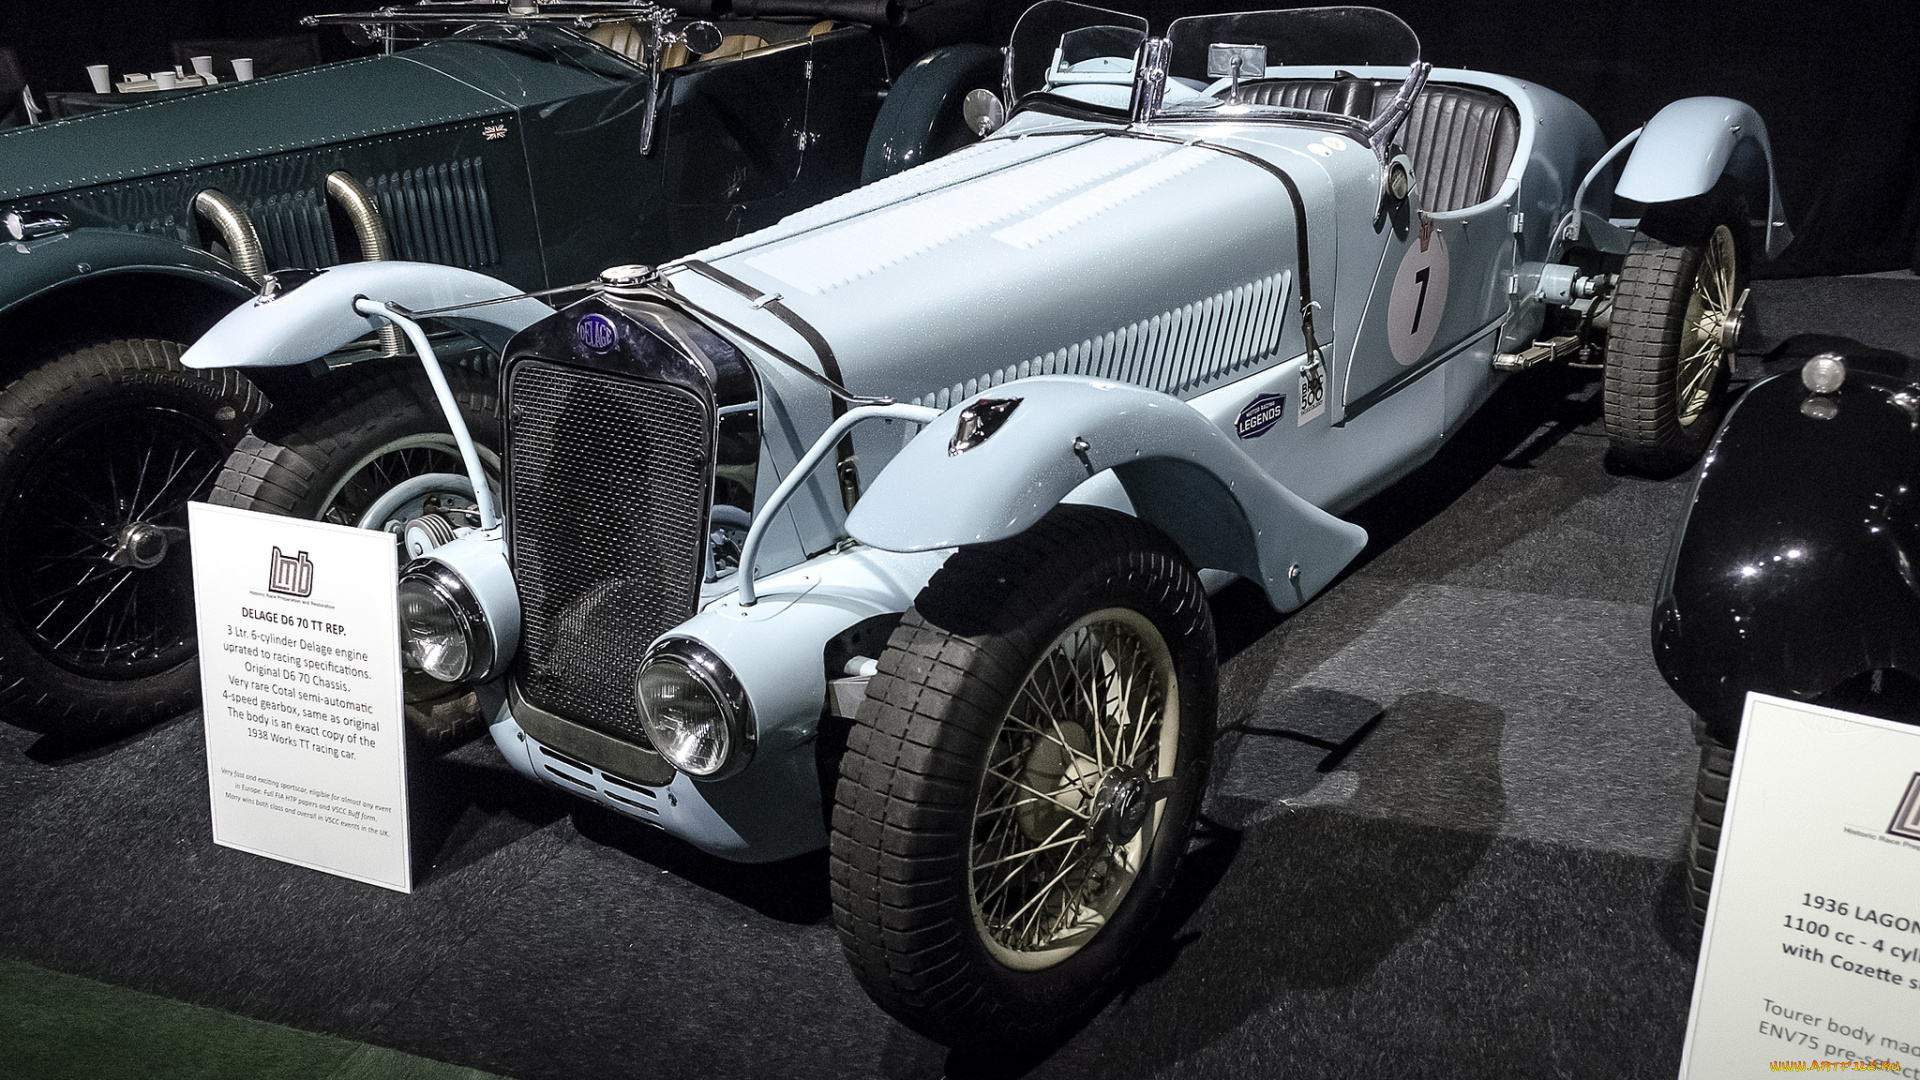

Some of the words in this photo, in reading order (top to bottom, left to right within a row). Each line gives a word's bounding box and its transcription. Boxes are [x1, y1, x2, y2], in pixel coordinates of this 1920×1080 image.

[1410, 265, 1430, 335] 7
[579, 320, 612, 348] DELAGE
[1301, 387, 1324, 410] 500
[1239, 405, 1281, 432] LEGENDS
[241, 606, 278, 624] DELAGE
[280, 614, 294, 627] D6
[296, 617, 309, 629] 70
[311, 619, 323, 632] TT
[325, 622, 346, 637] REP.
[223, 642, 259, 658] uprated
[260, 649, 271, 660] to
[273, 652, 302, 669] racing
[303, 658, 372, 680] specifications.
[226, 624, 233, 636] 3
[234, 626, 249, 639] Ltr.
[250, 629, 298, 648] 6-cylinder
[299, 638, 333, 657] Delage
[334, 647, 369, 662] engine
[228, 674, 249, 690] Very
[251, 681, 270, 693] rare
[271, 683, 296, 698] Cotal
[298, 691, 373, 715] semi-automatic
[244, 661, 281, 678] Original
[282, 668, 296, 682] D6
[298, 671, 311, 685] 70
[312, 675, 351, 693] Chassis.
[222, 689, 258, 707] 4-speed
[260, 699, 301, 718] gearbox,
[302, 708, 328, 722] same
[330, 714, 341, 725] as
[342, 716, 380, 732] original
[227, 706, 245, 720] The
[246, 710, 270, 727] body
[271, 715, 279, 728] is
[280, 720, 293, 730] an
[294, 723, 320, 737] exact
[321, 729, 345, 744] copy
[346, 733, 358, 744] of
[359, 735, 376, 749] the
[247, 727, 269, 741] 1938
[269, 732, 298, 747] Works
[298, 738, 310, 750] TT
[312, 743, 340, 759] racing
[340, 749, 357, 761] car.
[1843, 826, 1877, 840] Historic
[1878, 835, 1901, 846] Race
[1802, 893, 1849, 916] 1936
[1783, 915, 1830, 938] 1100
[1834, 931, 1855, 945] cc
[1872, 939, 1885, 953] 4
[1782, 942, 1824, 963] with
[1830, 954, 1903, 986] Cozette
[1758, 1020, 1820, 1050] ENV75
[1763, 998, 1822, 1027] Tourer
[1827, 1017, 1875, 1046] body
